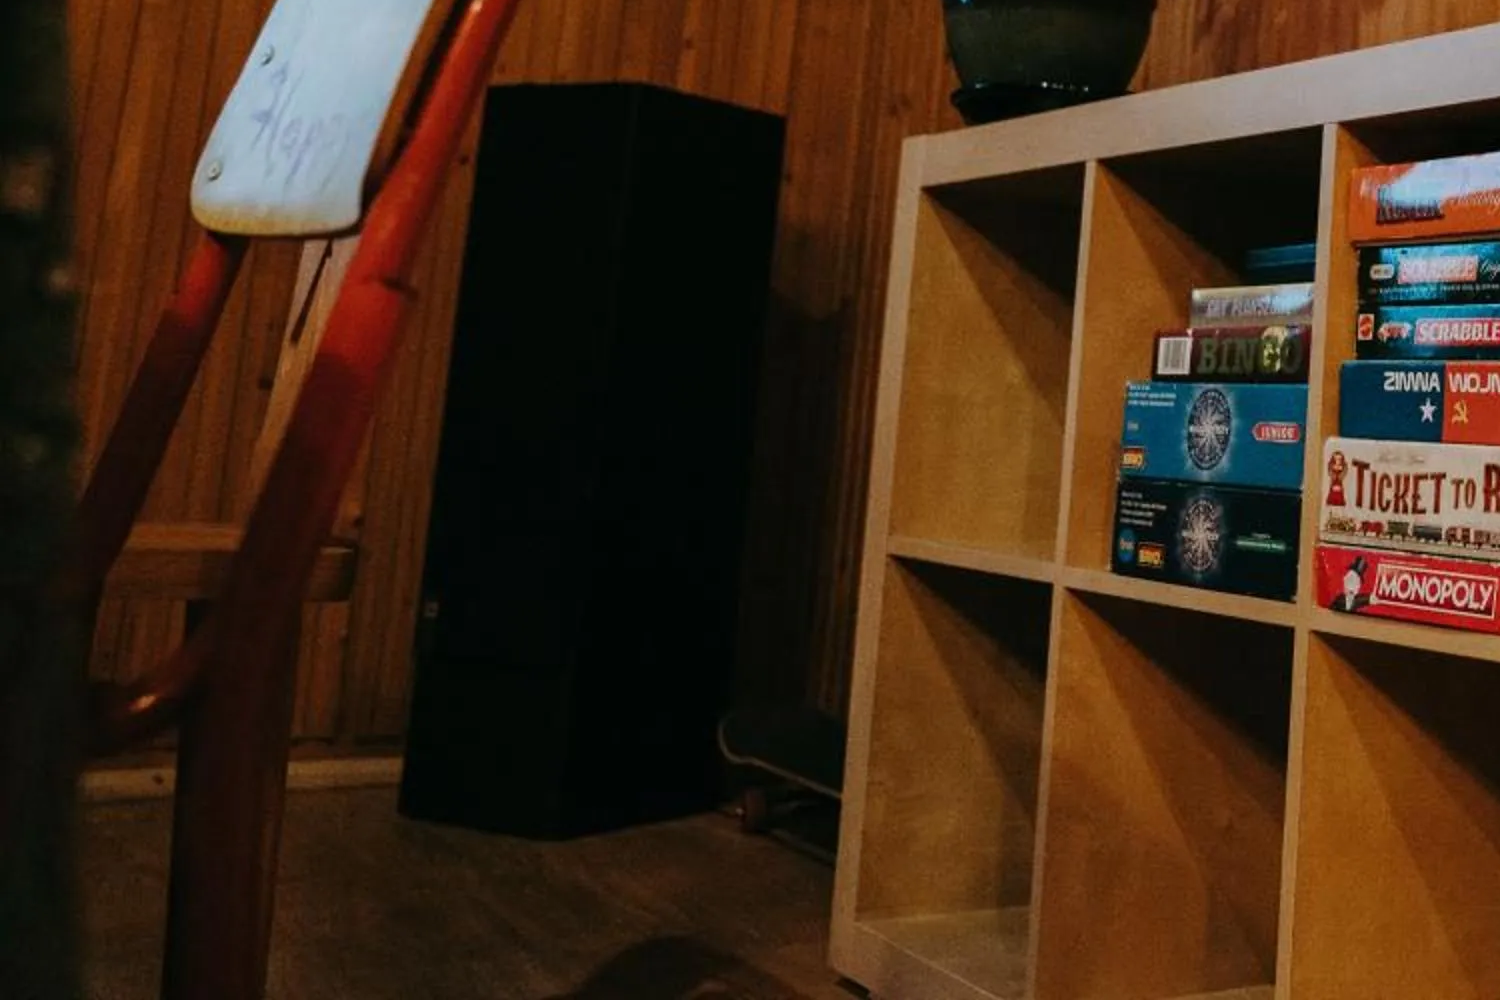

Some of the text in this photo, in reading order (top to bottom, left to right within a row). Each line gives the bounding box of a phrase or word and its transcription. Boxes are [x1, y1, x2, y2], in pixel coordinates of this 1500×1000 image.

[1383, 371, 1441, 393] ZIMNA
[1351, 458, 1447, 517] TICKET
[1450, 477, 1477, 510] TO
[1377, 572, 1494, 612] MONOPOLY
